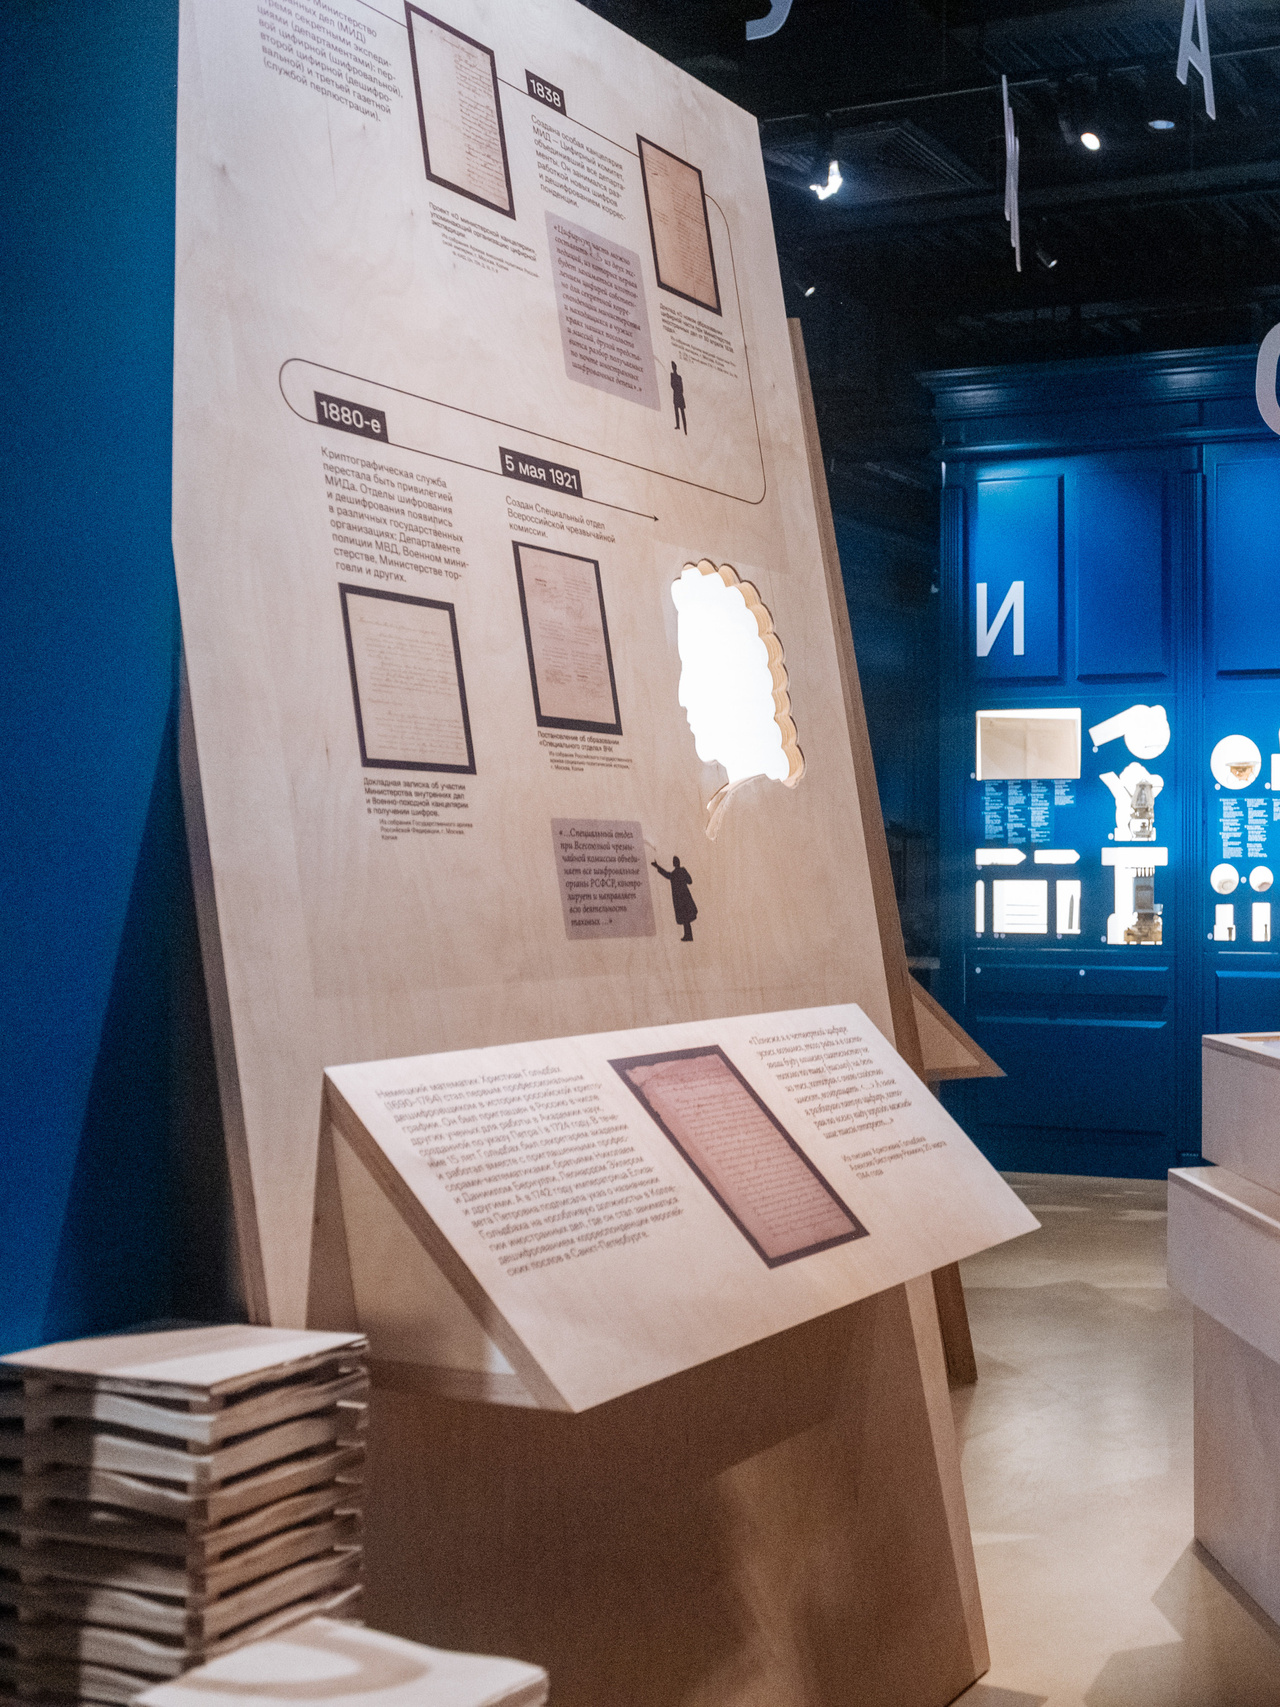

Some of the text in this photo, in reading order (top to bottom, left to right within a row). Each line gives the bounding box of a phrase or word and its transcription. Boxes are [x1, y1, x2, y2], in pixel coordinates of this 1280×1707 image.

[257, 5, 288, 26] циями
[377, 67, 395, 80] пер-
[258, 18, 275, 32] вой
[278, 29, 326, 58] цифирной
[294, 12, 351, 47] секретными
[353, 43, 391, 66] экспеди-
[318, 13, 366, 44] дел (МИД)
[260, 31, 392, 102] второй цифирной (дешифро-
[261, 45, 304, 72] вальной)
[315, 71, 350, 94] третьей
[352, 90, 391, 114] газетной
[263, 56, 307, 86] (службой
[530, 79, 561, 107] 1838
[319, 400, 382, 434] 1880-е
[320, 446, 447, 488] Криптографическая служба
[322, 462, 453, 502] перестала быть привилегией
[504, 455, 579, 490] 5 мая 1921
[335, 493, 405, 515] дешифрования
[407, 510, 453, 527] появились
[359, 483, 395, 500] Отделы
[397, 495, 452, 514] шифрования
[505, 495, 605, 529] Создан Специальный отдел
[328, 505, 463, 542] в различных государственных
[507, 507, 615, 543] Всероссийской чрезвычайной
[332, 533, 372, 548] полиции
[402, 545, 441, 562] Военном
[443, 557, 469, 568] мини-
[399, 531, 460, 554] Департаменте
[335, 561, 363, 573] говли
[379, 554, 442, 576] Министерстве
[444, 570, 462, 580] тор-
